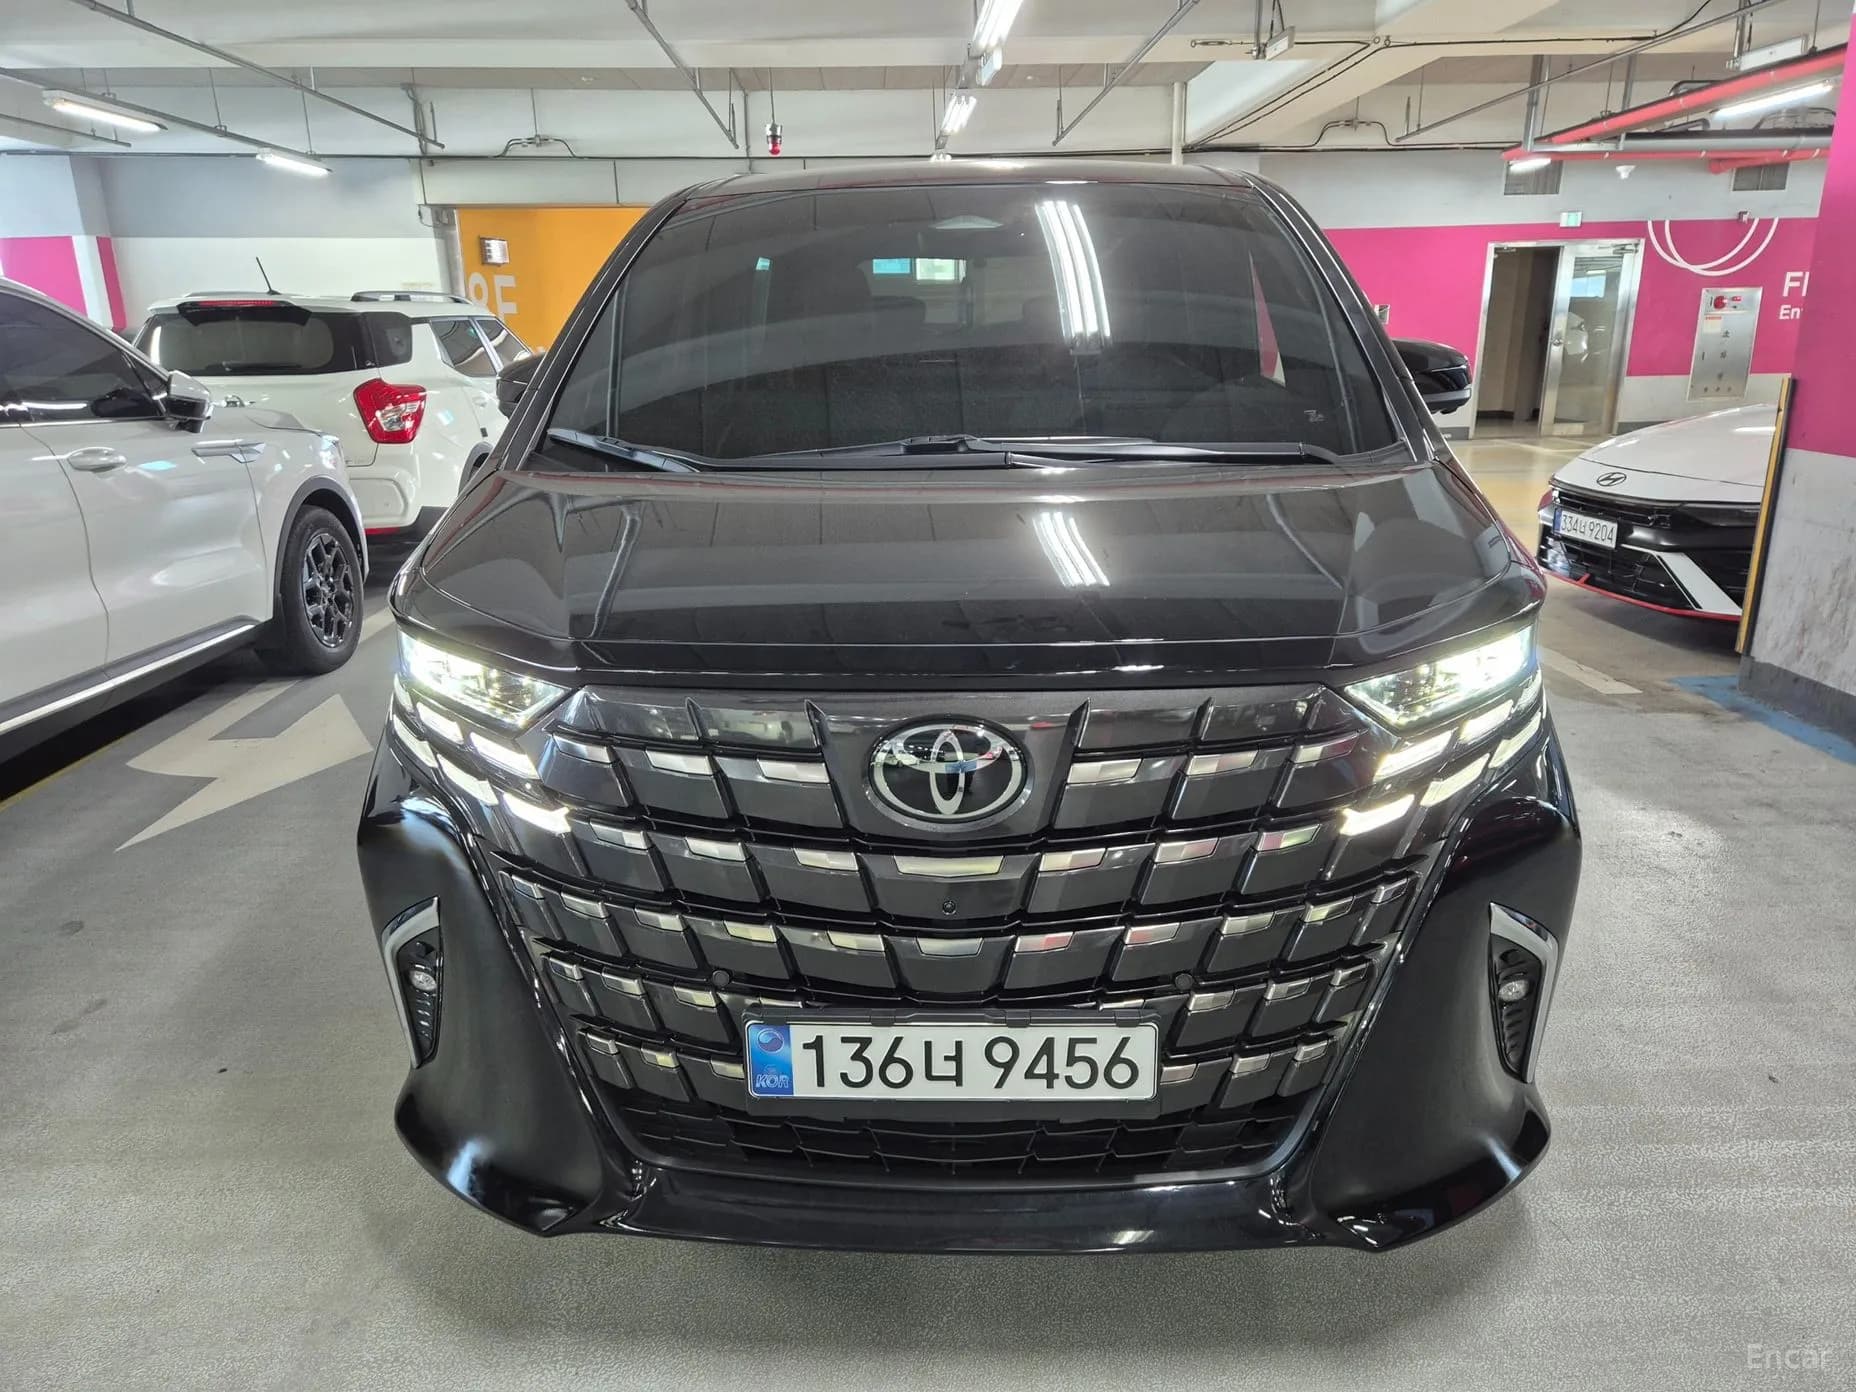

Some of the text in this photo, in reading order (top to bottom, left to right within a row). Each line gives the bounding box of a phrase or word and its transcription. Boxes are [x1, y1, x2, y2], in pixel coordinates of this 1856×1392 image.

[1779, 304, 1803, 319] En
[1588, 521, 1615, 544] 9204
[802, 1034, 1140, 1089] 136너 9456
[755, 1074, 790, 1089] KOR
